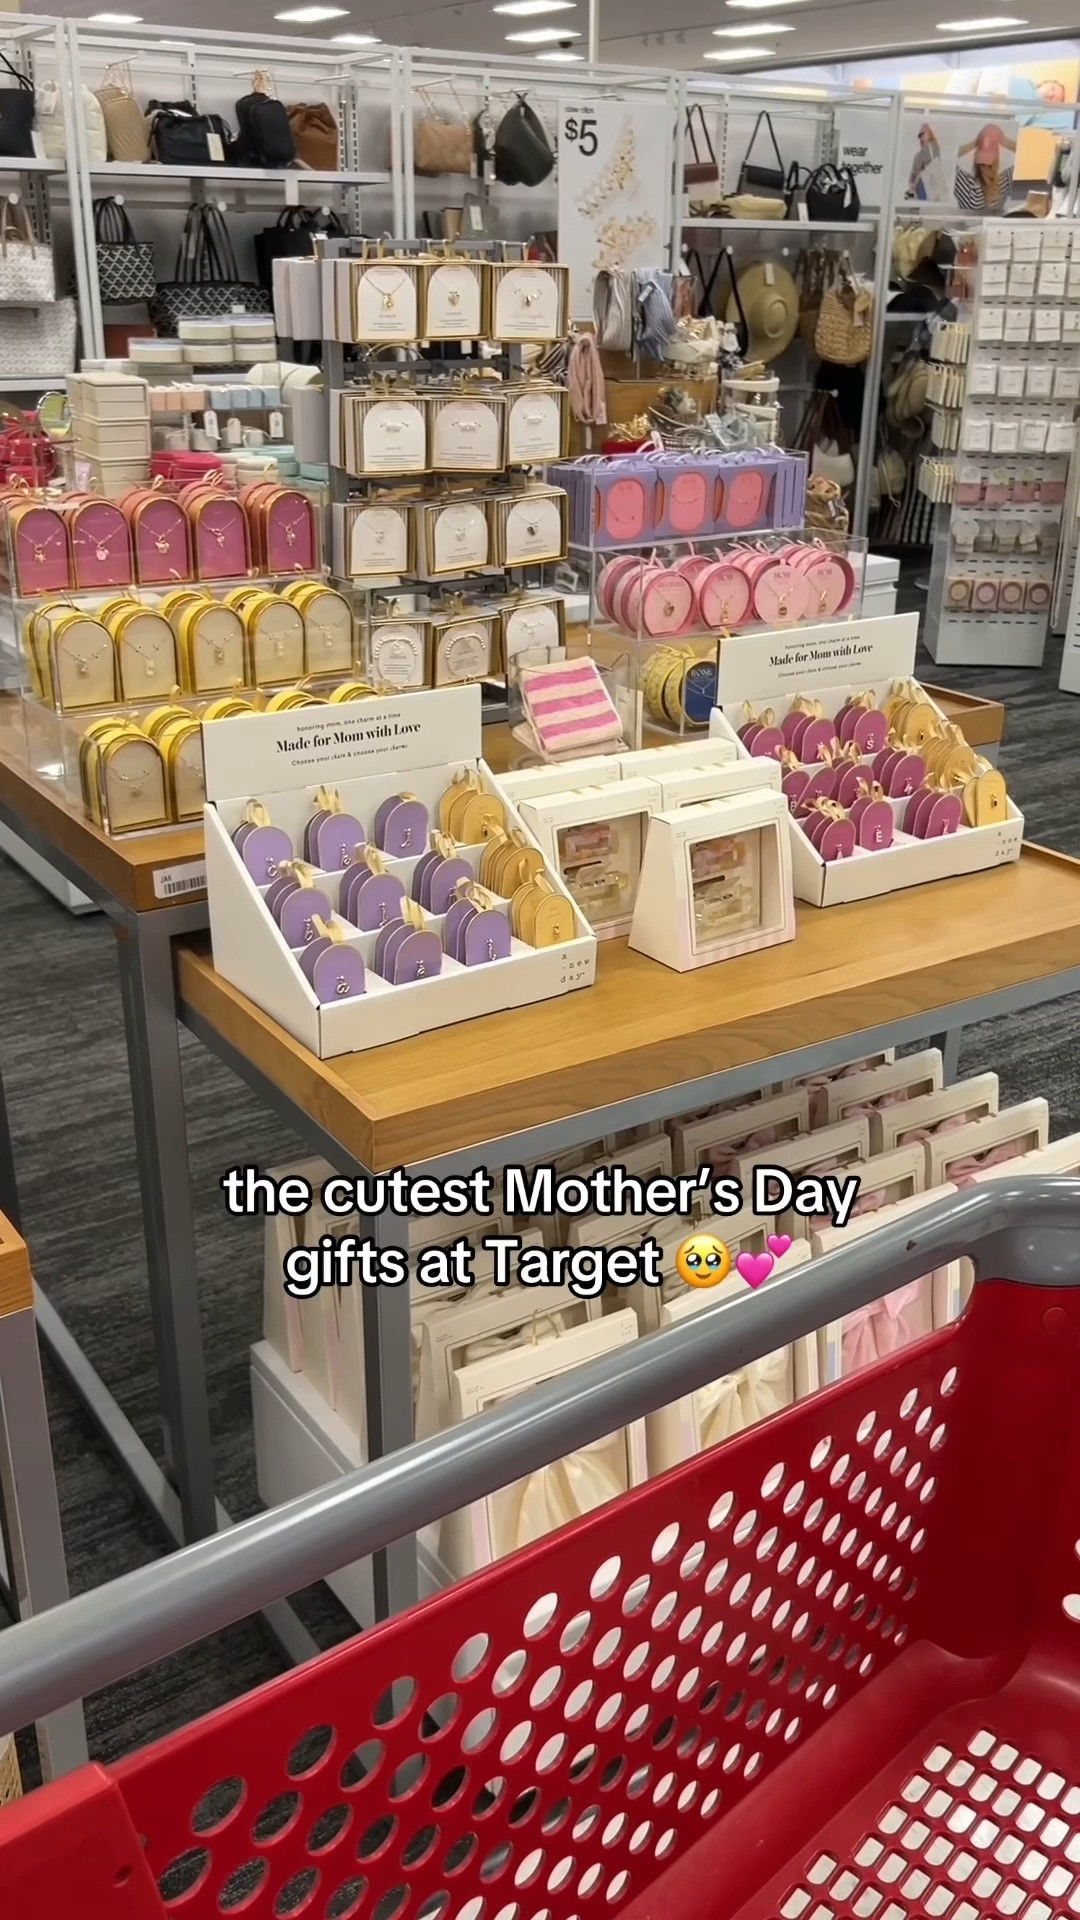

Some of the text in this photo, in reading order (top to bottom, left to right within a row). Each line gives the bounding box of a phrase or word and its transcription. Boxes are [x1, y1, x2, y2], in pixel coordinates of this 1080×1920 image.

[564, 117, 599, 157] $5
[842, 146, 868, 157] wear
[769, 644, 873, 667] Made for Mom with Love
[296, 723, 325, 732] honoring
[276, 723, 421, 753] Made for Mom with Love
[353, 749, 375, 757] choose
[569, 959, 590, 969] new
[560, 972, 585, 983] day
